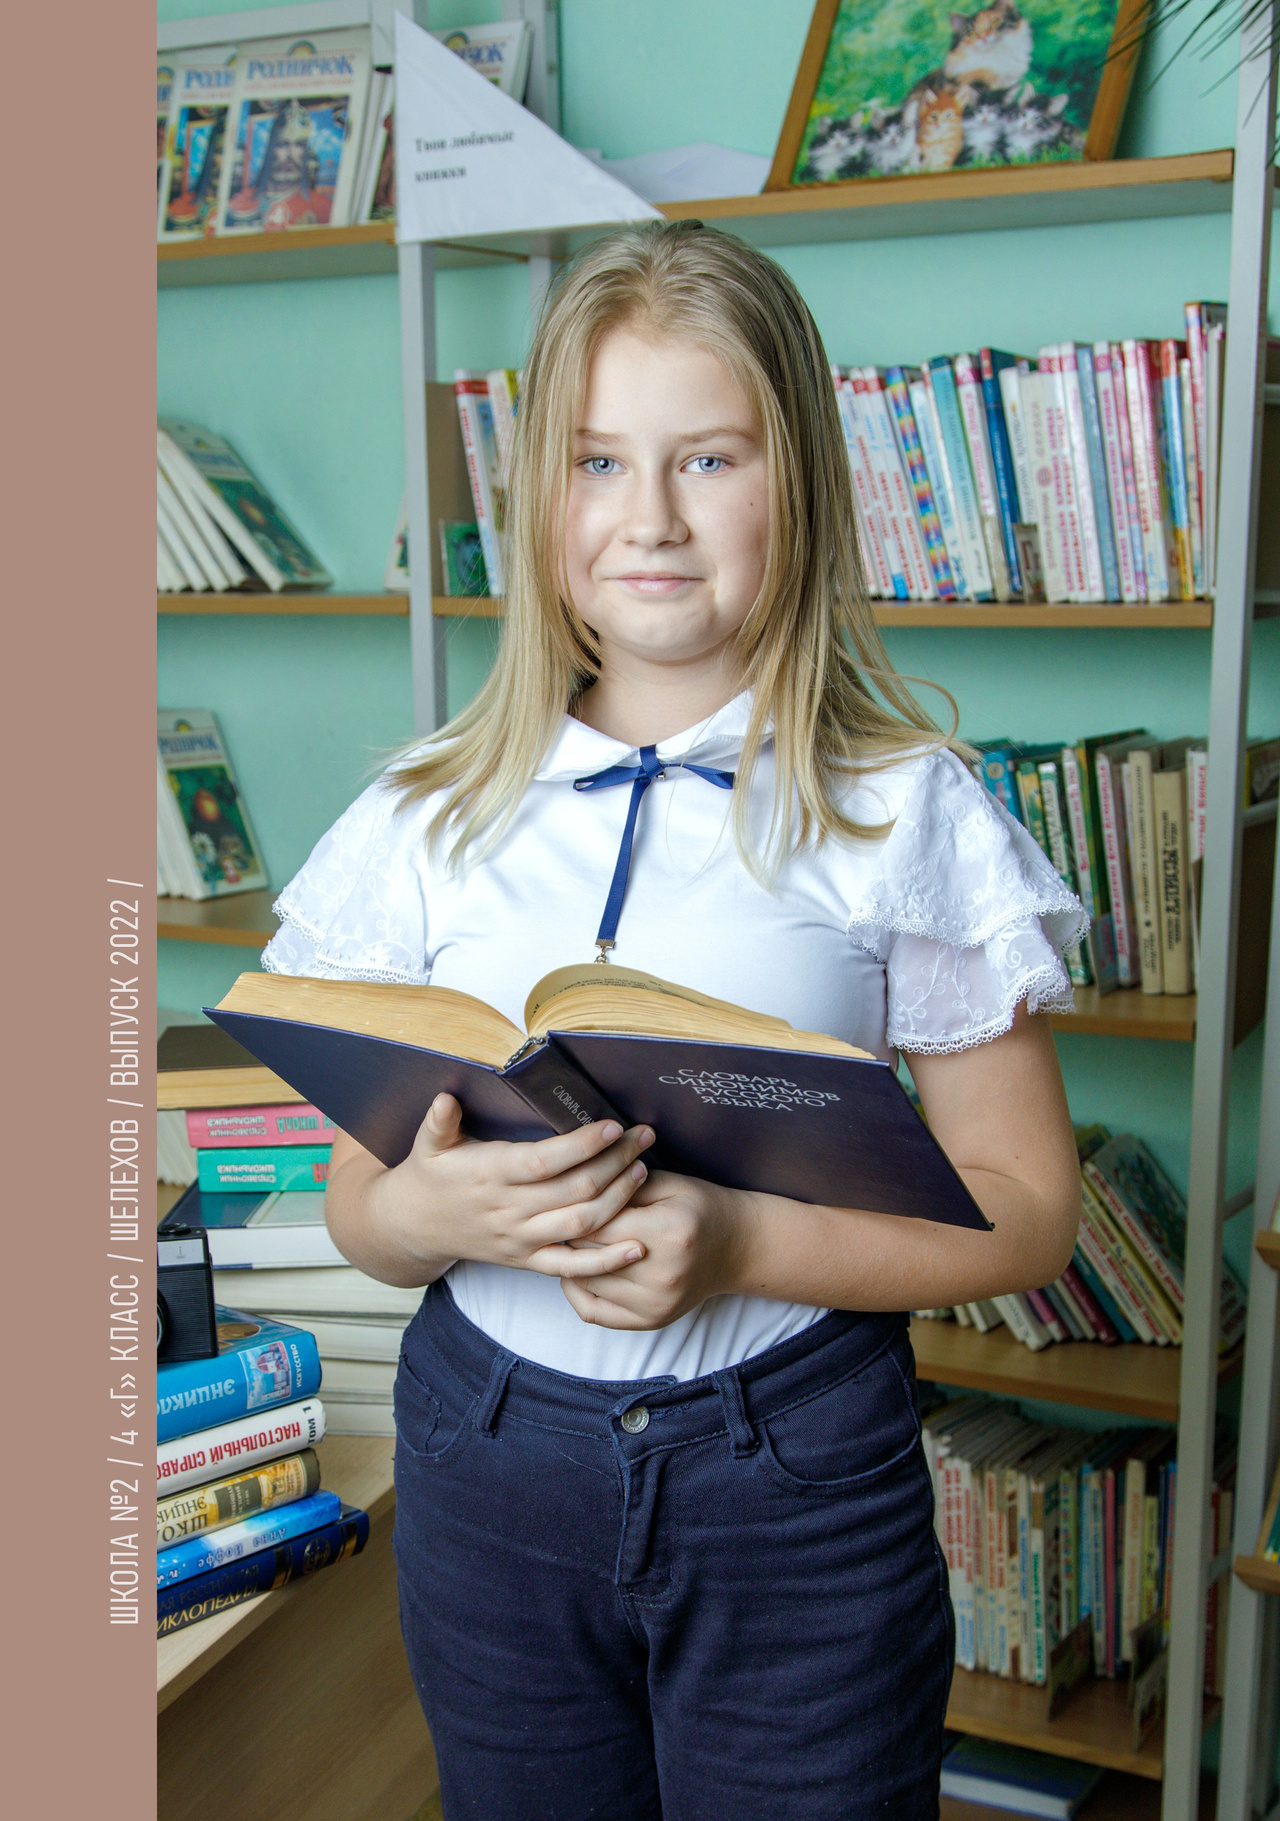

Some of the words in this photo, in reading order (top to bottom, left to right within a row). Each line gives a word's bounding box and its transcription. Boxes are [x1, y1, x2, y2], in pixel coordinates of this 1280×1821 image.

[678, 1069, 798, 1088] СЛОВАРЬ
[658, 1076, 841, 1102] СИНОНИМОВ
[691, 1086, 826, 1107] РУССКОГО
[552, 1085, 580, 1115] СЛОВАРЬ
[701, 1095, 794, 1112] ЯЗЫКА
[206, 1115, 266, 1126] школьника
[209, 1127, 268, 1137] Справочник
[216, 1163, 276, 1174] школьника
[219, 1174, 277, 1184] Справочник
[290, 1343, 303, 1388] ИСКУССТВО
[307, 1417, 318, 1446] ТОМ
[211, 1421, 302, 1466] НАСТОЛЬНЫЙ
[253, 1528, 287, 1547] Анна
[198, 1543, 243, 1567] Иоффе
